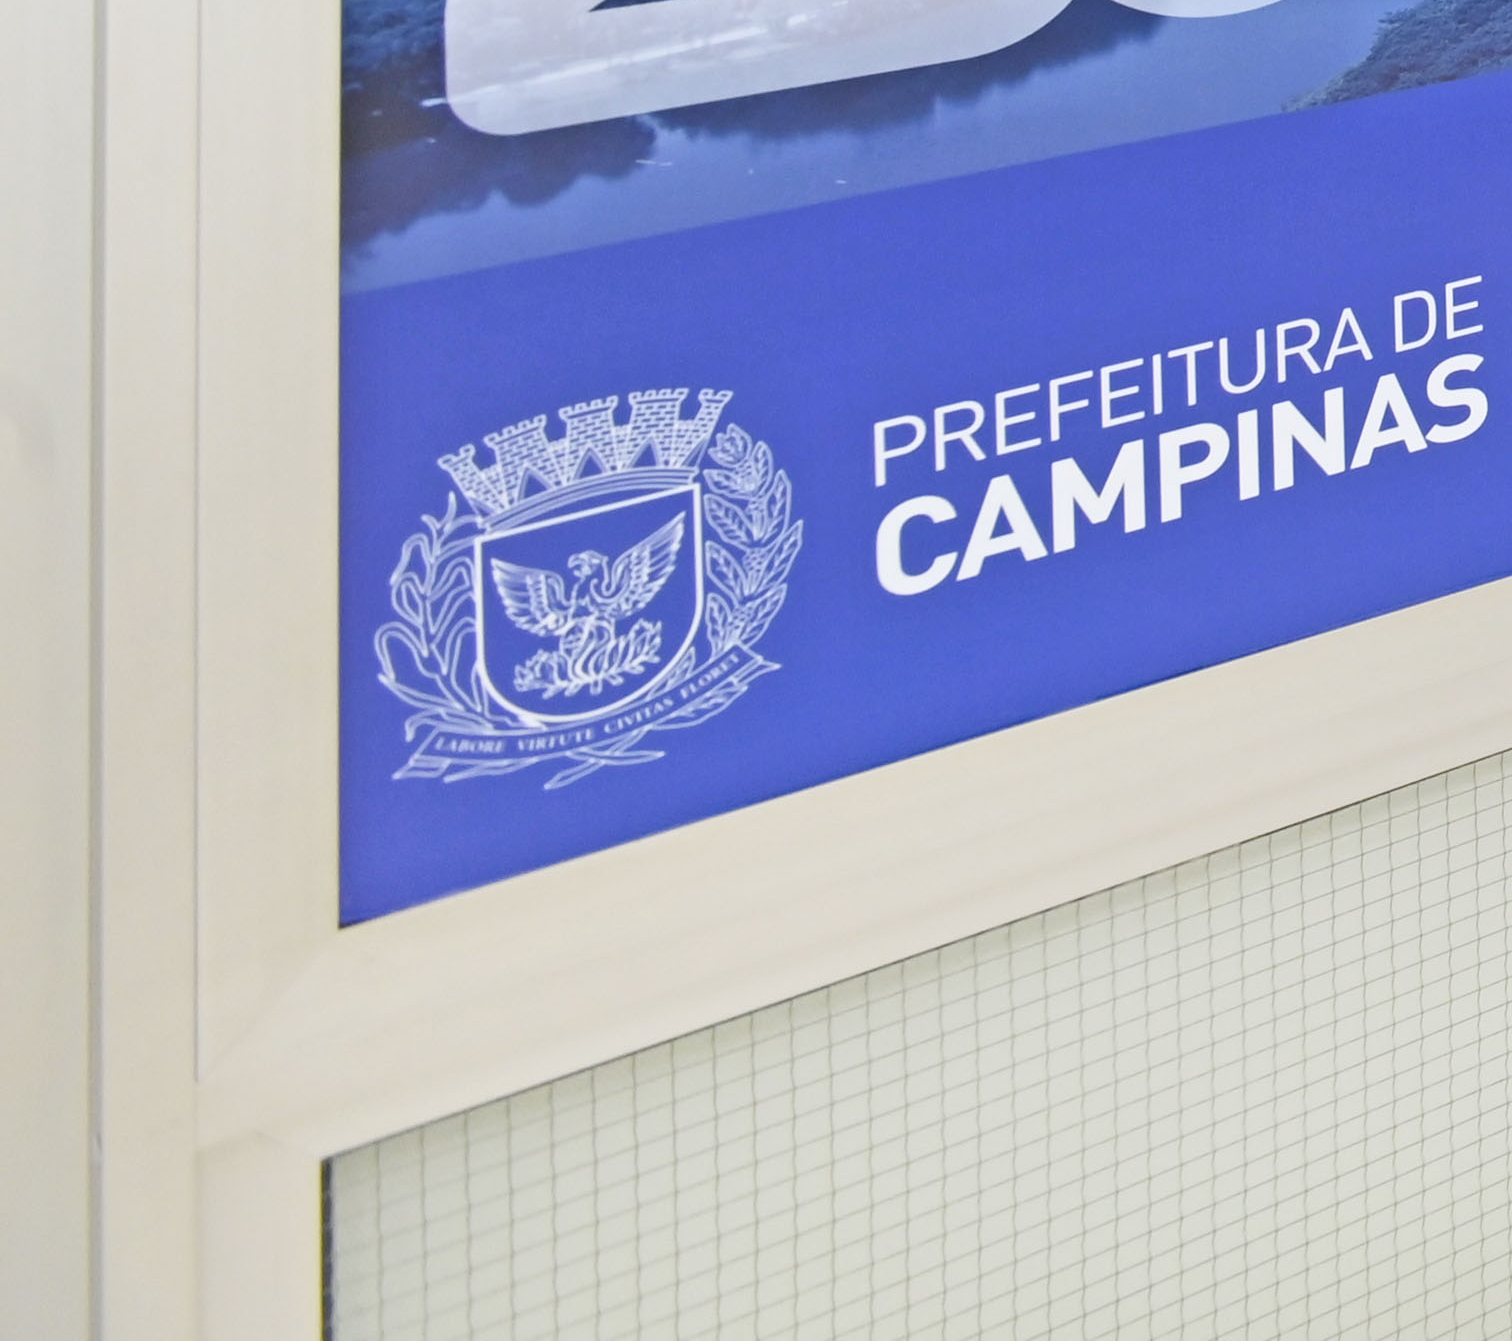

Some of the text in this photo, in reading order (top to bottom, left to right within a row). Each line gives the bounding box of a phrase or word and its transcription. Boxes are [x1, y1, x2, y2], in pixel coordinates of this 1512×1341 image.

[870, 274, 1487, 487] PREFEITURA DE
[873, 349, 1492, 600] CAMPINAS
[434, 651, 742, 754] LABORE VIRTUTE CIVITAS FLORET
